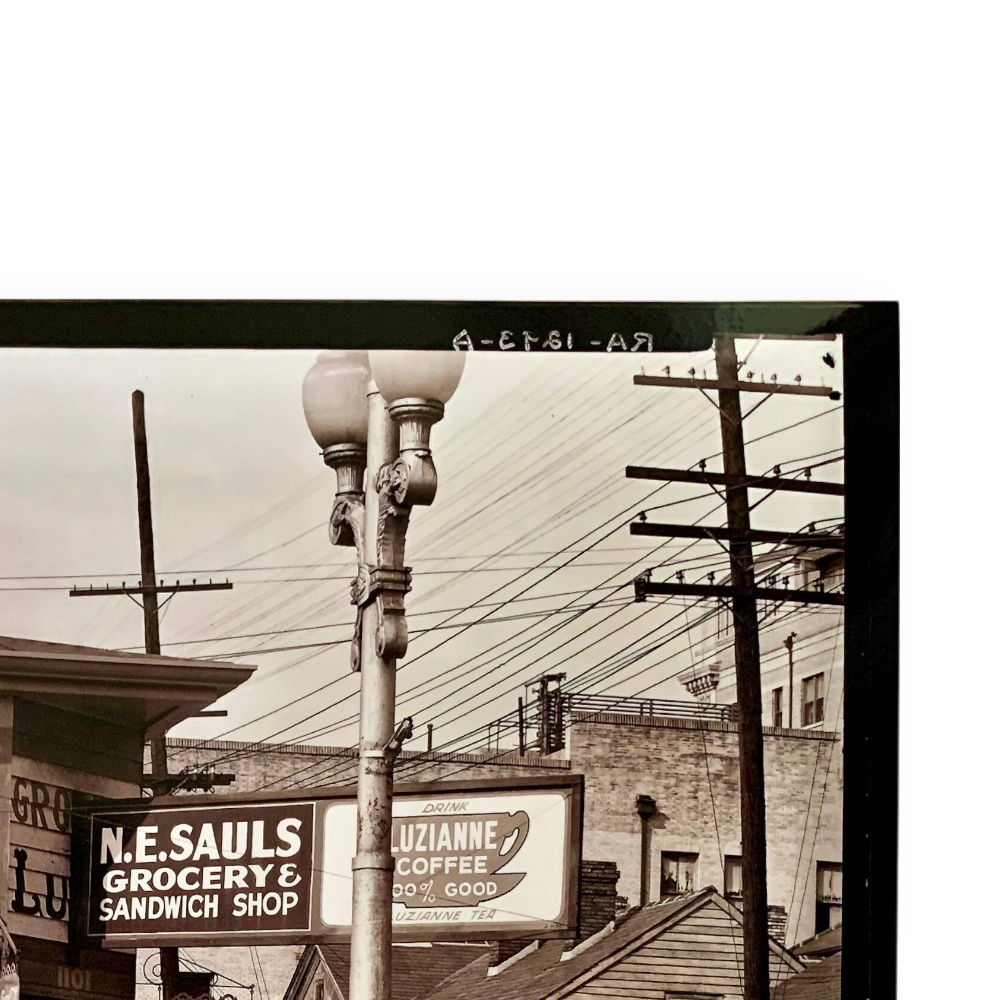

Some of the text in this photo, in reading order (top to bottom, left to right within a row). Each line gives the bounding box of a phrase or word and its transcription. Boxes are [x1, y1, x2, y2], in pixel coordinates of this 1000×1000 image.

[422, 802, 469, 814] DRINK
[397, 855, 488, 876] COFFEE
[102, 863, 302, 894] GROCERY &
[392, 879, 498, 903] 00% GOOD
[99, 891, 299, 922] SANDWICH SHOP
[392, 908, 497, 922] UZIANNE TEA
[58, 966, 91, 991] 1101
